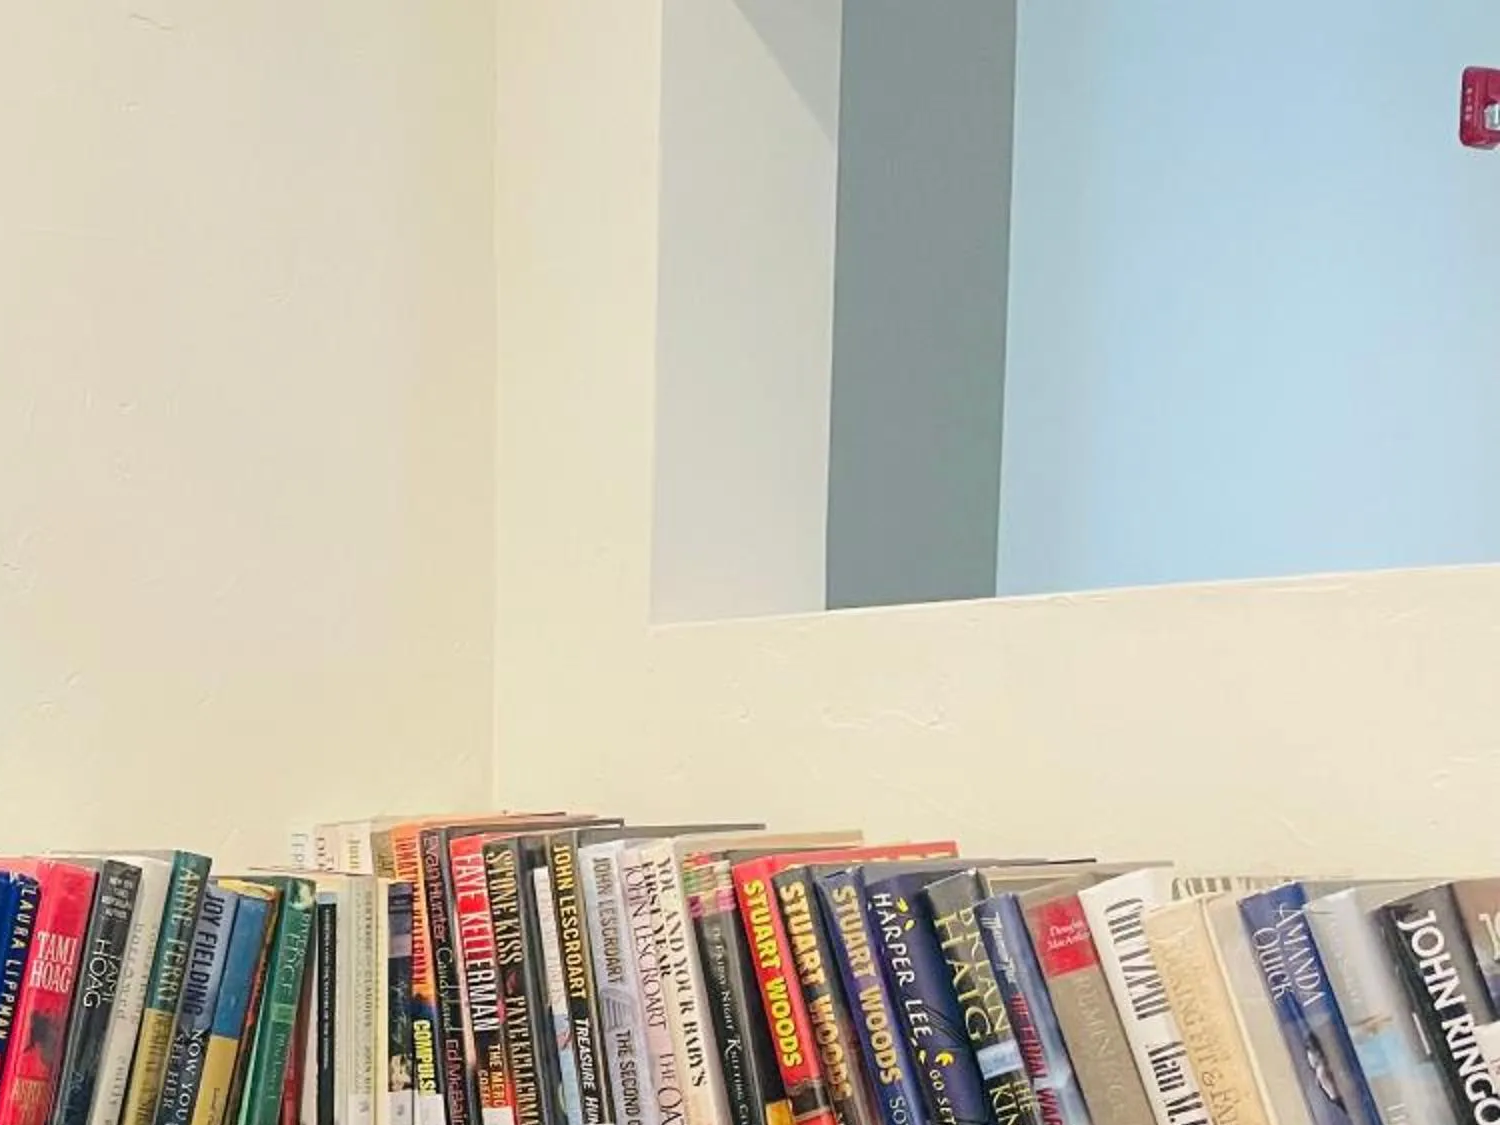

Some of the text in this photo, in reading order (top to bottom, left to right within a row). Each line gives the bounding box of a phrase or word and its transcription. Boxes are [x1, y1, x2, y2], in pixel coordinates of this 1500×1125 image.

[485, 849, 517, 912] STONE
[623, 865, 649, 918] JOHN
[10, 887, 36, 949] LAURA
[36, 931, 77, 967] TAMI
[155, 866, 200, 1002] ANNE PERRY
[494, 917, 523, 965] KISS
[641, 860, 671, 977] FIRST YEAR
[871, 892, 917, 986] HARPER
[1273, 901, 1326, 1006] AMANDA
[29, 958, 73, 994] HOAG
[82, 938, 111, 1009] HOAG
[452, 852, 506, 1107] FAYE KELLERMAN THE MERC
[553, 844, 600, 1125] JOHN LESCROART TREASURE HUN
[592, 856, 640, 1117] JOHN LESCROART THE SECOND
[632, 924, 667, 1030] LESCROART
[656, 856, 707, 1087] YOU AND YOUR BABY'S
[742, 879, 804, 1068] STUART WOODS
[778, 881, 826, 986] STUART
[806, 996, 853, 1100] WOODS
[830, 884, 877, 980] STUART
[856, 984, 903, 1085] WOODS
[932, 911, 993, 1042] HAIG
[1249, 925, 1295, 1001] QUICK
[1396, 909, 1467, 1011] JOHN
[175, 892, 224, 1121] JOY FIELDING NOW YOU
[504, 995, 528, 1039] FAYE
[719, 990, 737, 1030] NIGHT
[903, 997, 931, 1039] LEE
[444, 1038, 460, 1063] Ed
[926, 1068, 946, 1091] GO
[1144, 1035, 1195, 1093] Alan
[161, 1072, 178, 1110] HER
[934, 1095, 955, 1125] SET
[1011, 1078, 1036, 1114] THE
